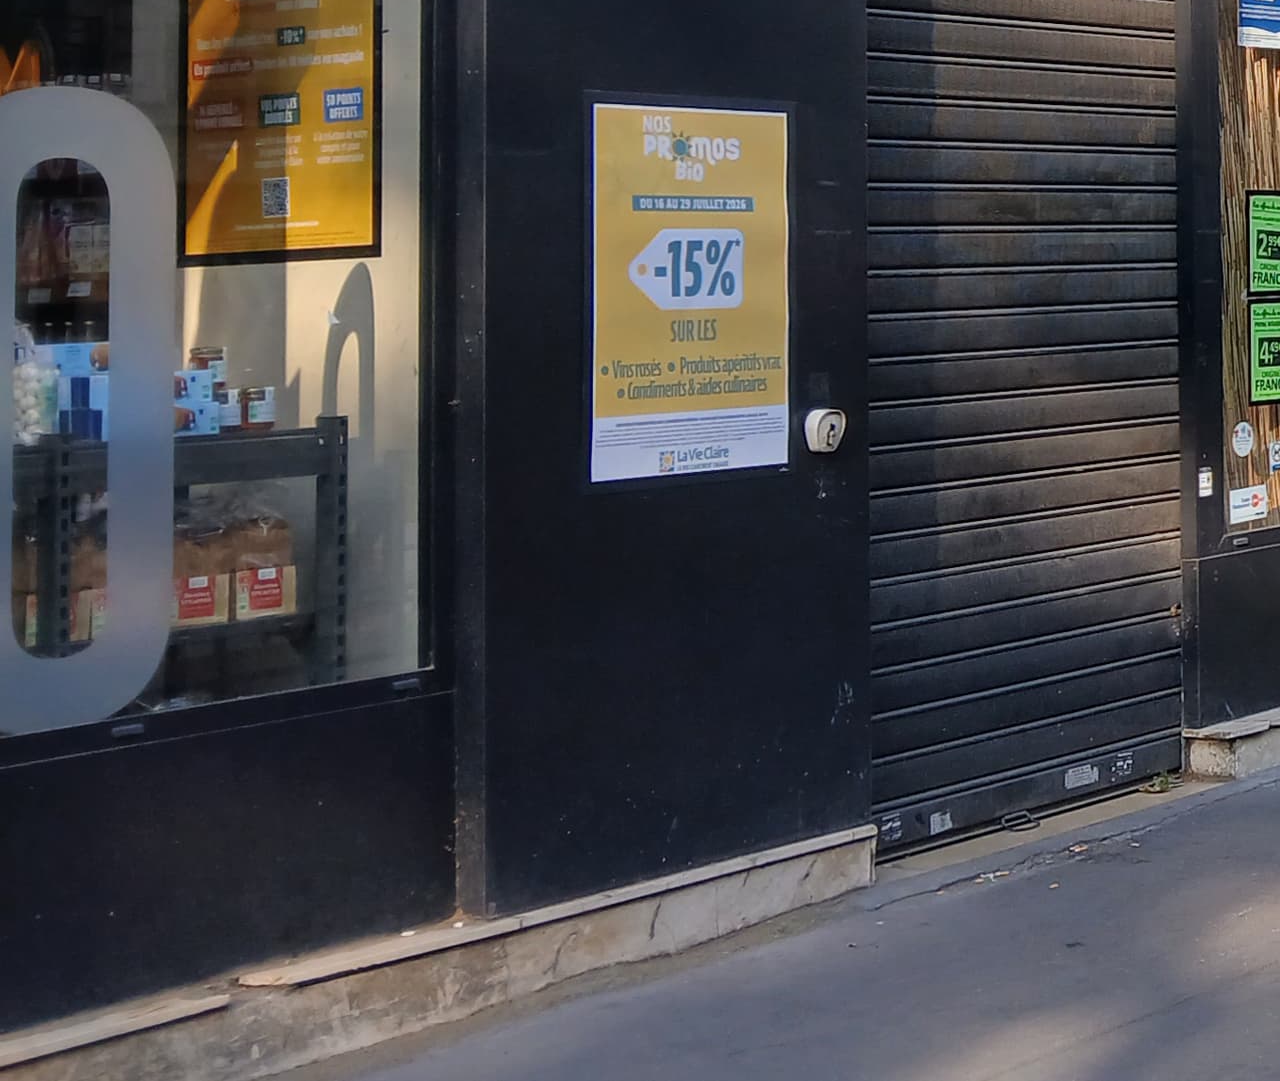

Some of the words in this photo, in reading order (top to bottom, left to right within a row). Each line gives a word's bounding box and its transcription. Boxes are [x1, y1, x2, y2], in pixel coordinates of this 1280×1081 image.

[643, 115, 673, 133] NOS
[666, 199, 679, 209] AU
[670, 319, 695, 342] SUR
[697, 319, 717, 341] LES
[612, 359, 634, 379] Vins
[634, 358, 662, 378] rosés
[680, 356, 721, 375] Produits
[627, 379, 687, 400] Condiments
[687, 379, 696, 396] &
[696, 377, 722, 396] aides
[723, 375, 768, 394] culinaires
[676, 450, 688, 463] La
[688, 447, 704, 462] Vie
[703, 445, 730, 460] Claire
